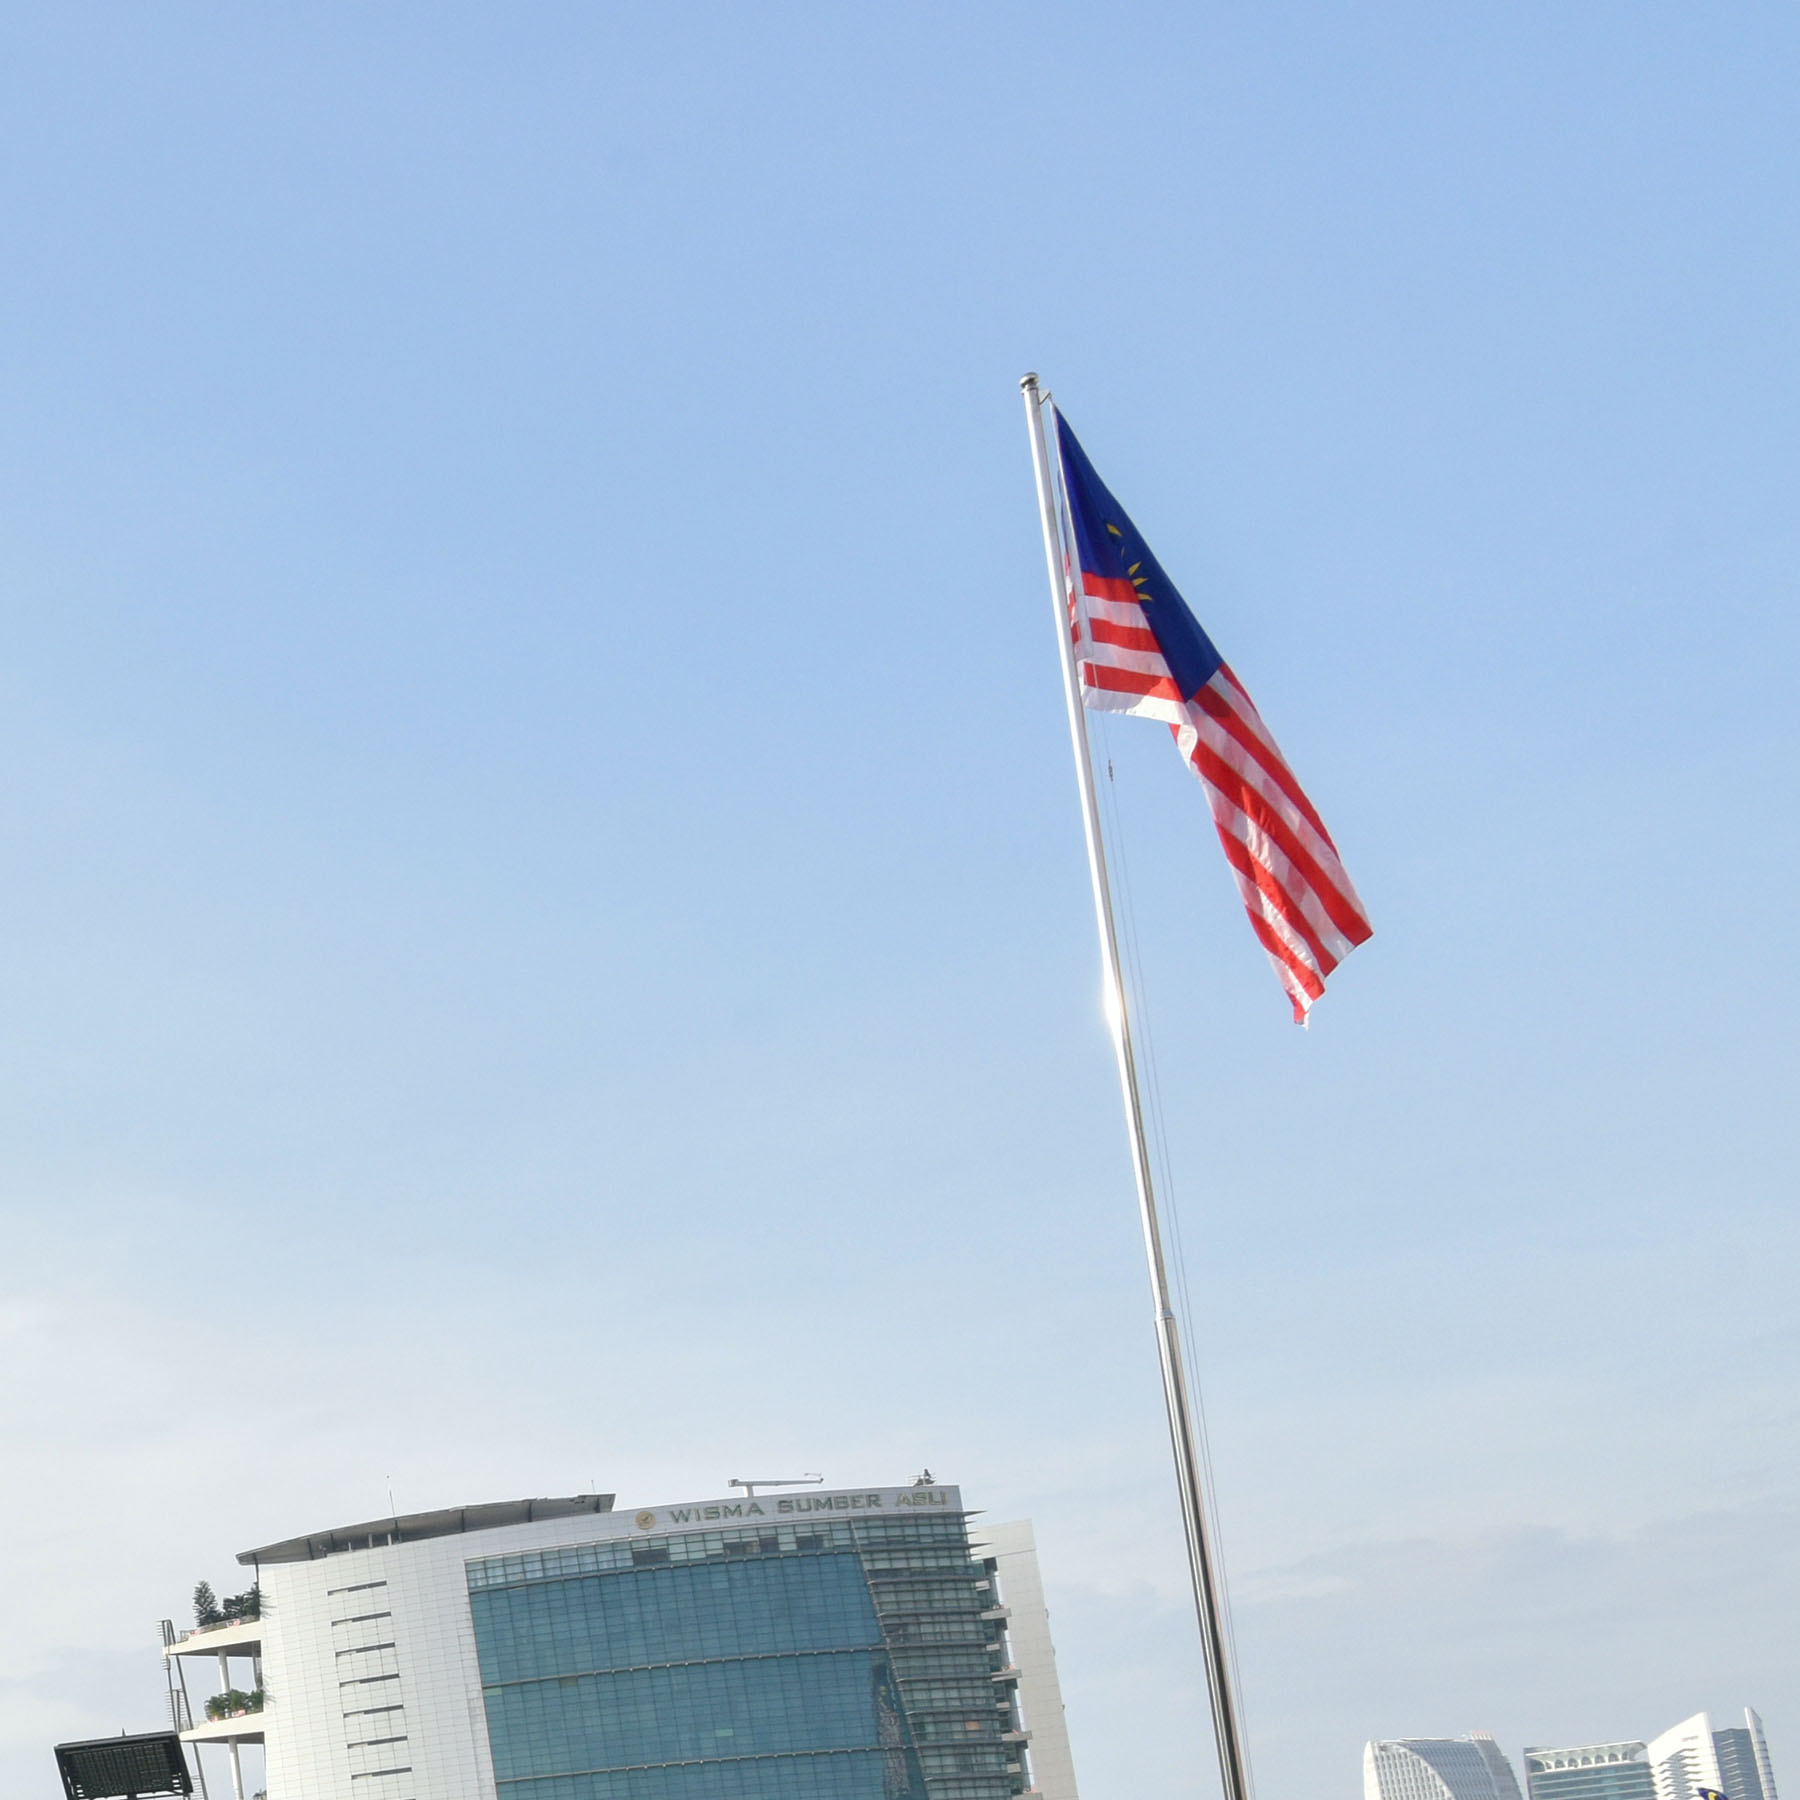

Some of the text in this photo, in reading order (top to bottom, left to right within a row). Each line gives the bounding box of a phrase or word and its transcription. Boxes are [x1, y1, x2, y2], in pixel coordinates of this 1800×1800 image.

[669, 1490, 947, 1524] WISMA SUMBER ASLI
